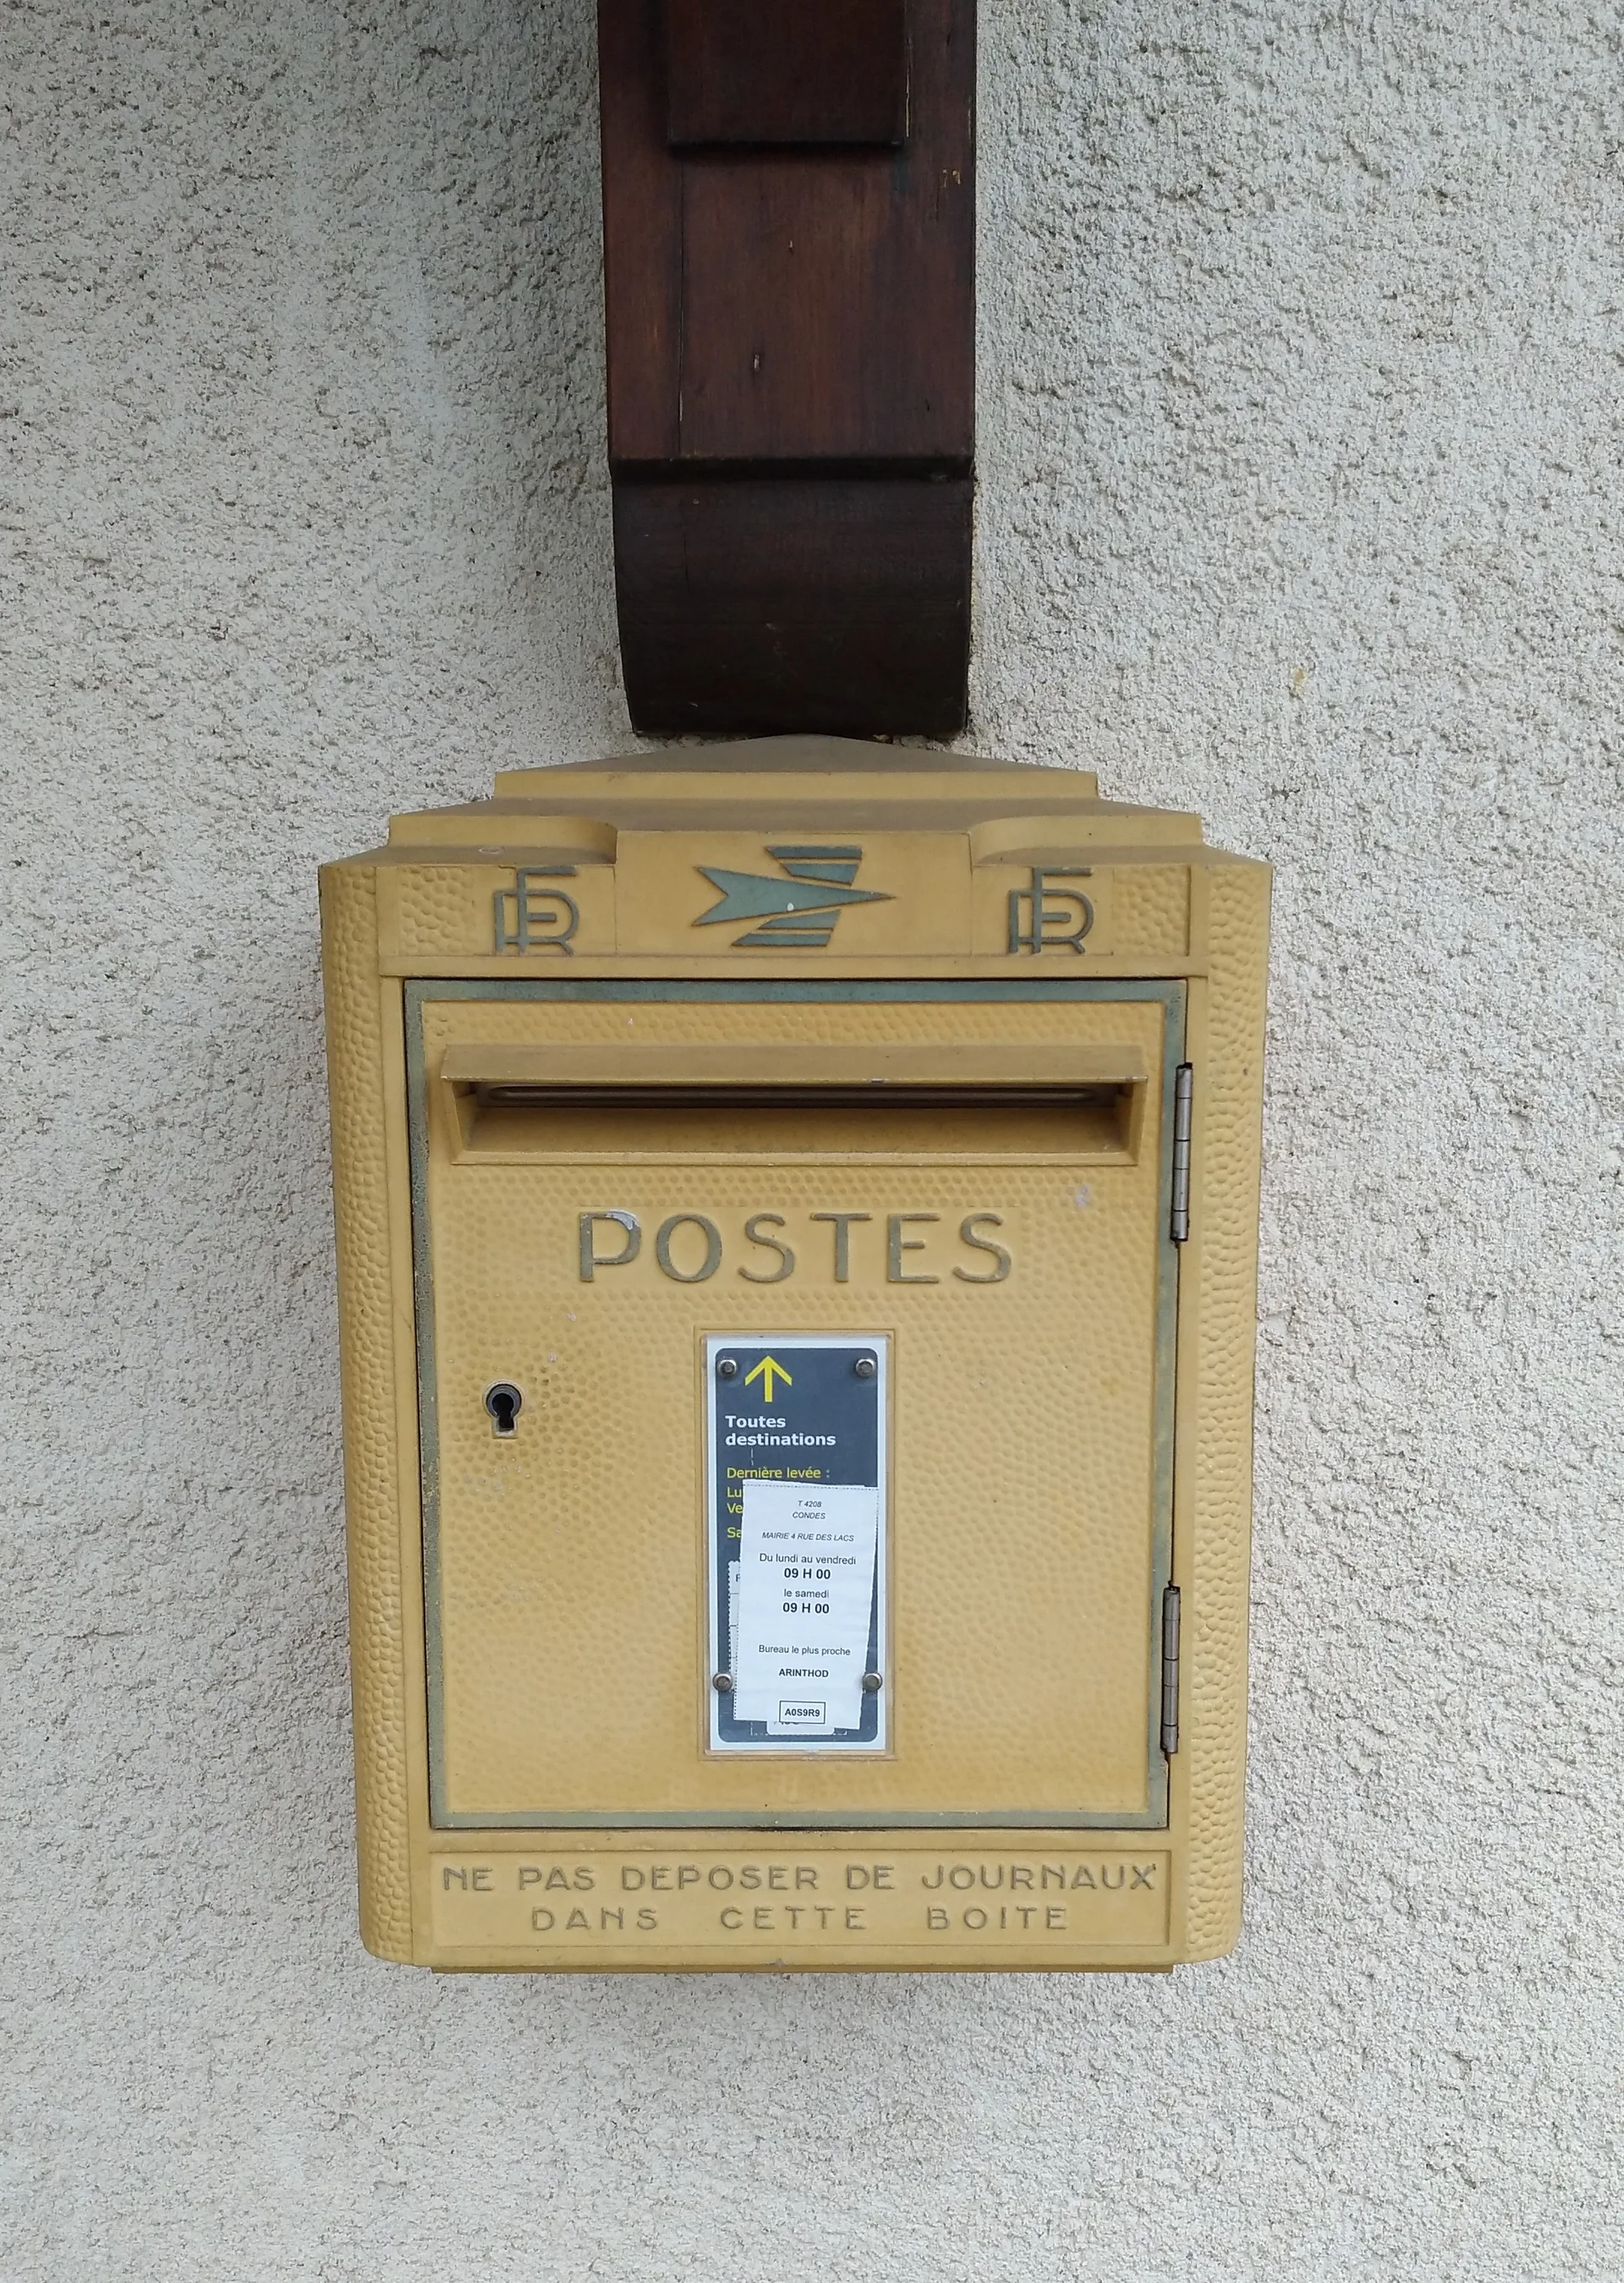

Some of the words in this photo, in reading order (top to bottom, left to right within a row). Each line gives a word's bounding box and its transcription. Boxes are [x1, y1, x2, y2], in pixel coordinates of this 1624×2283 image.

[578, 1209, 1012, 1284] POSTES
[725, 1415, 787, 1429] Toutes
[725, 1433, 837, 1446] destinations
[727, 1467, 782, 1479] Dernière
[760, 1553, 773, 1562] Du
[776, 1554, 798, 1563] lundi
[816, 1555, 856, 1565] vendredi
[783, 1568, 799, 1578] 09
[803, 1569, 812, 1578] H
[816, 1569, 831, 1579] 00
[783, 1589, 793, 1597] le
[795, 1589, 829, 1598] samedi
[782, 1603, 798, 1612] 09
[801, 1603, 811, 1613] H
[815, 1604, 830, 1614] 00
[759, 1644, 789, 1654] Bureau
[792, 1645, 799, 1654] le
[802, 1646, 820, 1655] plus
[821, 1646, 851, 1656] proche
[778, 1668, 829, 1677] ARINTHOD
[442, 1866, 493, 1892] NE
[517, 1865, 596, 1891] PAS
[621, 1864, 819, 1891] DEPOSER
[845, 1864, 895, 1891] DE
[921, 1863, 1157, 1892] JOURNAUX
[531, 1907, 660, 1932] DANS
[719, 1905, 866, 1931] CETTE
[926, 1906, 1068, 1931] BOITE
